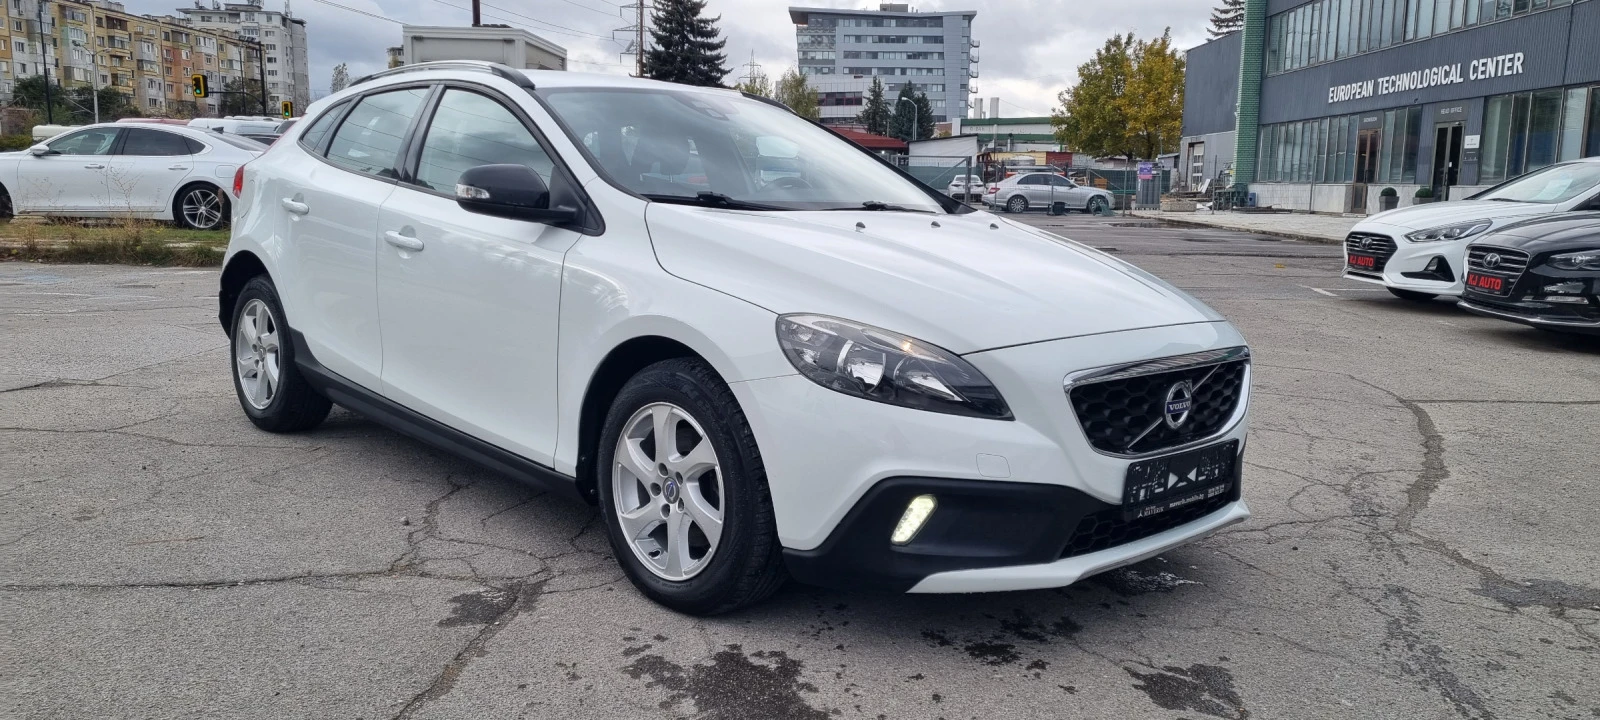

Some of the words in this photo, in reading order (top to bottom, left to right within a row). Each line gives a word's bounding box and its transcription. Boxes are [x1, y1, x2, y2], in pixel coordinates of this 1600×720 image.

[1328, 80, 1375, 103] EUROPEAN
[1378, 63, 1464, 95] TECHNOLOGICAL
[1469, 52, 1525, 81] CENTER
[1349, 254, 1356, 264] KJ
[1357, 256, 1374, 267] AUTO
[1468, 273, 1478, 286] KJ
[1479, 276, 1502, 290] AUTO
[1169, 400, 1190, 410] VOLVO
